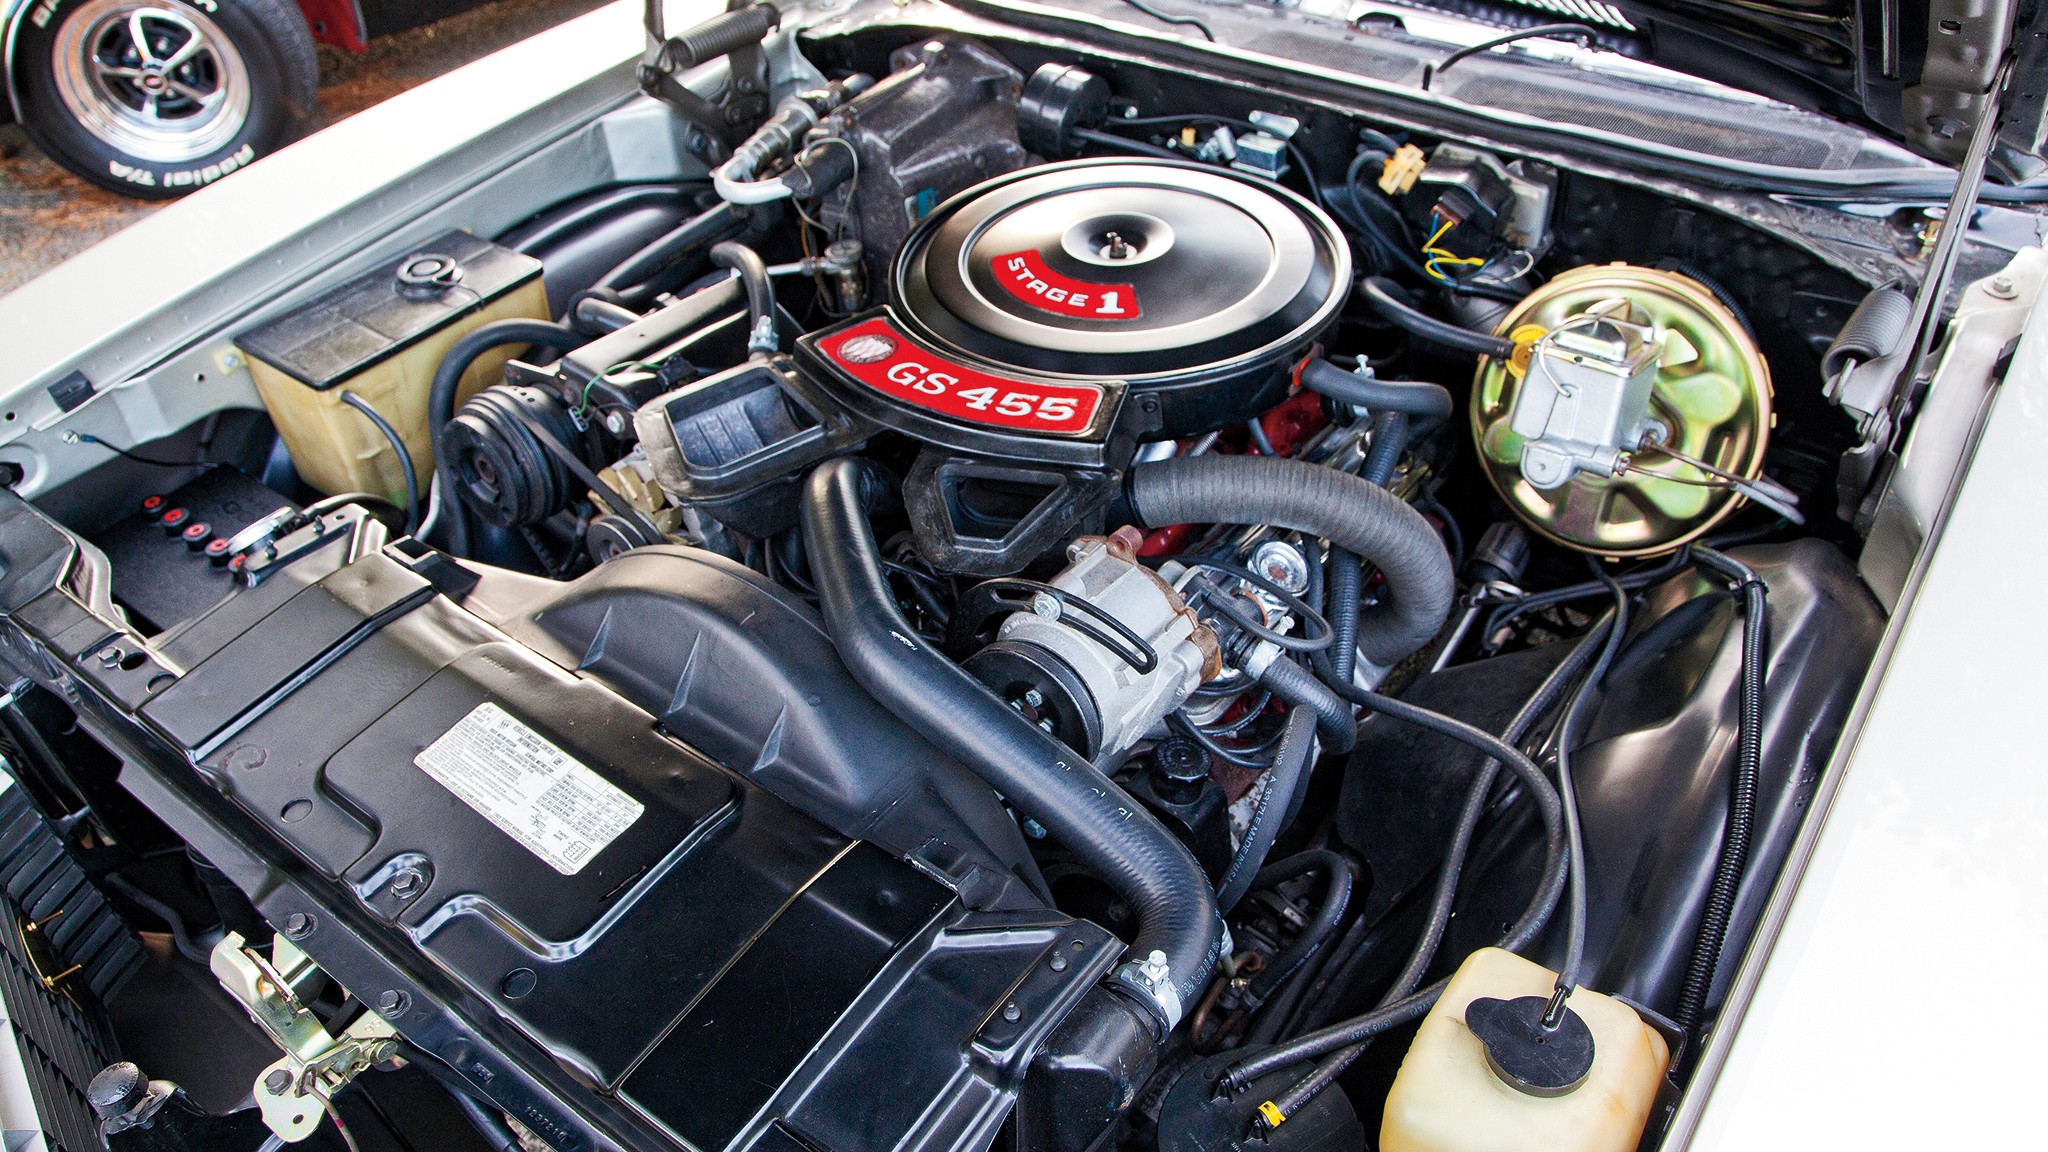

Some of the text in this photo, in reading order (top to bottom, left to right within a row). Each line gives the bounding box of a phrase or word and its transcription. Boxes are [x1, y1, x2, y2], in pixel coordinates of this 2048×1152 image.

[1008, 257, 1126, 314] STAGE 1
[886, 361, 1079, 421] GS 455
